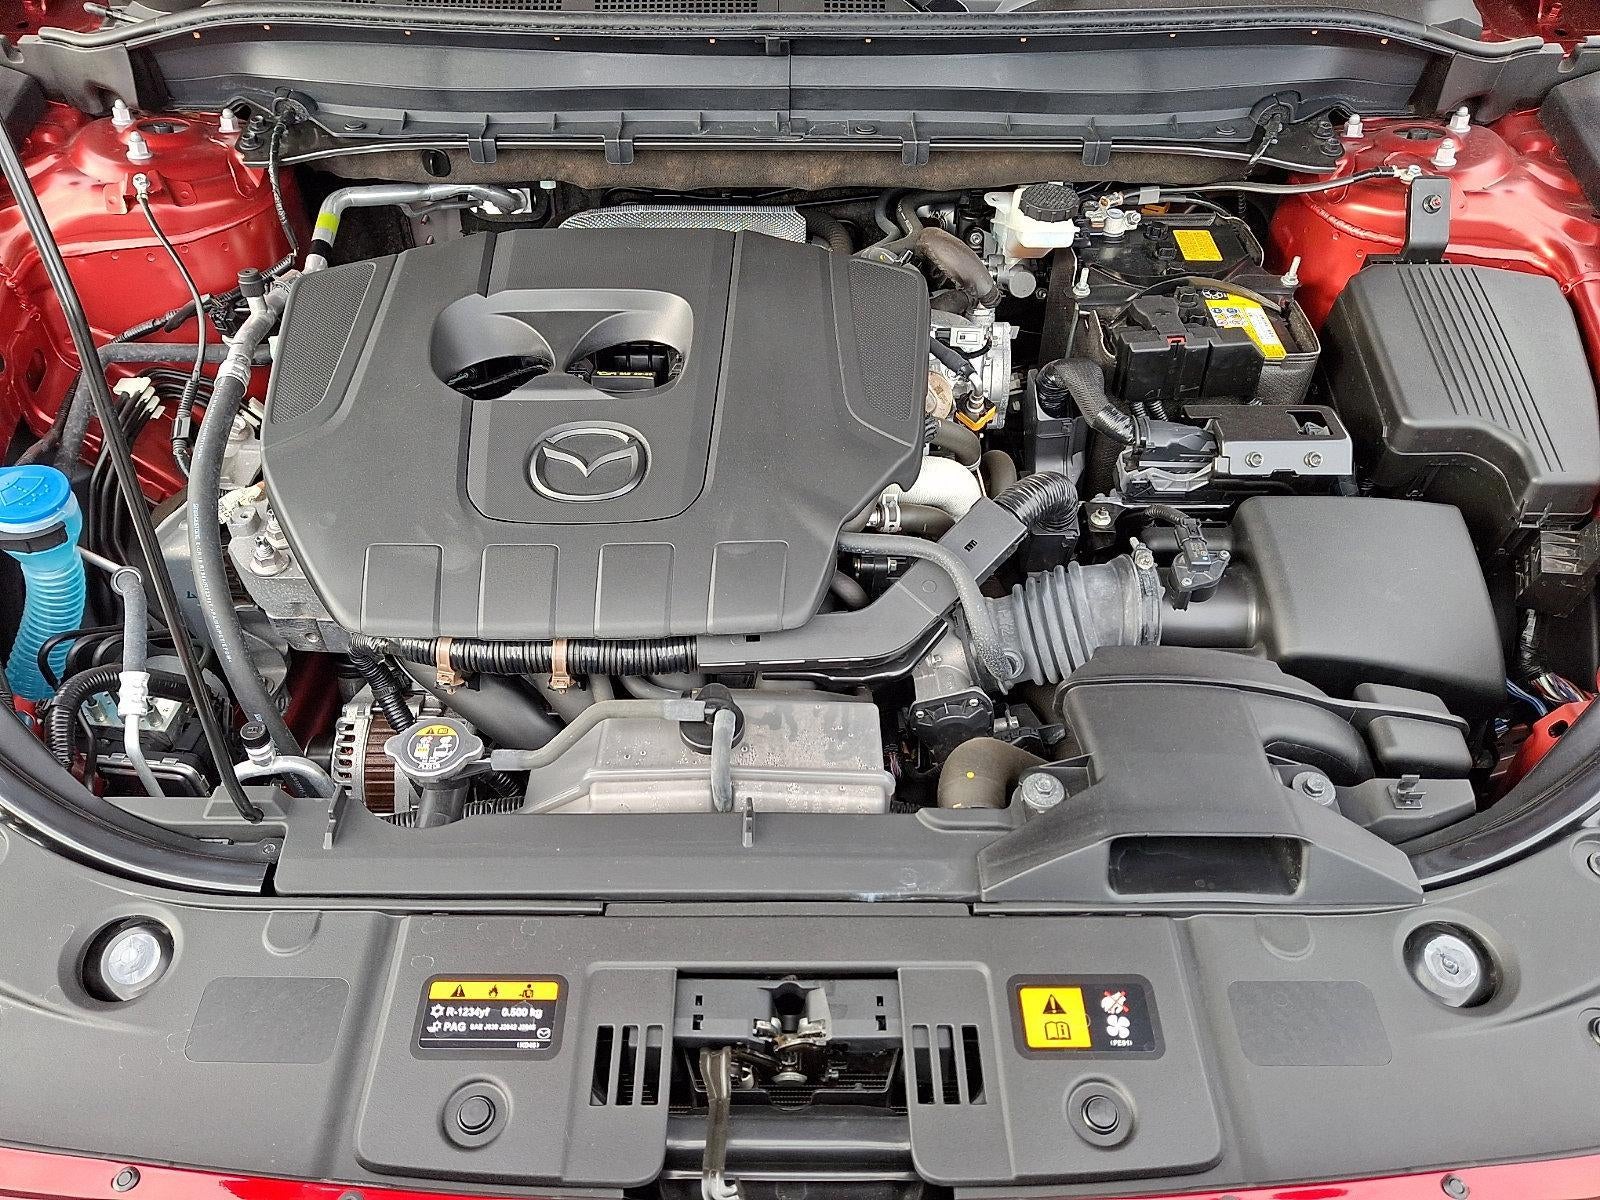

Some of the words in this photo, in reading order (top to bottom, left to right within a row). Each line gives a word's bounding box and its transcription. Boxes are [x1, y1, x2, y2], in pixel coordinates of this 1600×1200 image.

[445, 1006, 490, 1018] R-1234yf
[501, 1007, 528, 1017] 0.500
[529, 1007, 543, 1019] kg
[443, 1021, 466, 1032] PAG
